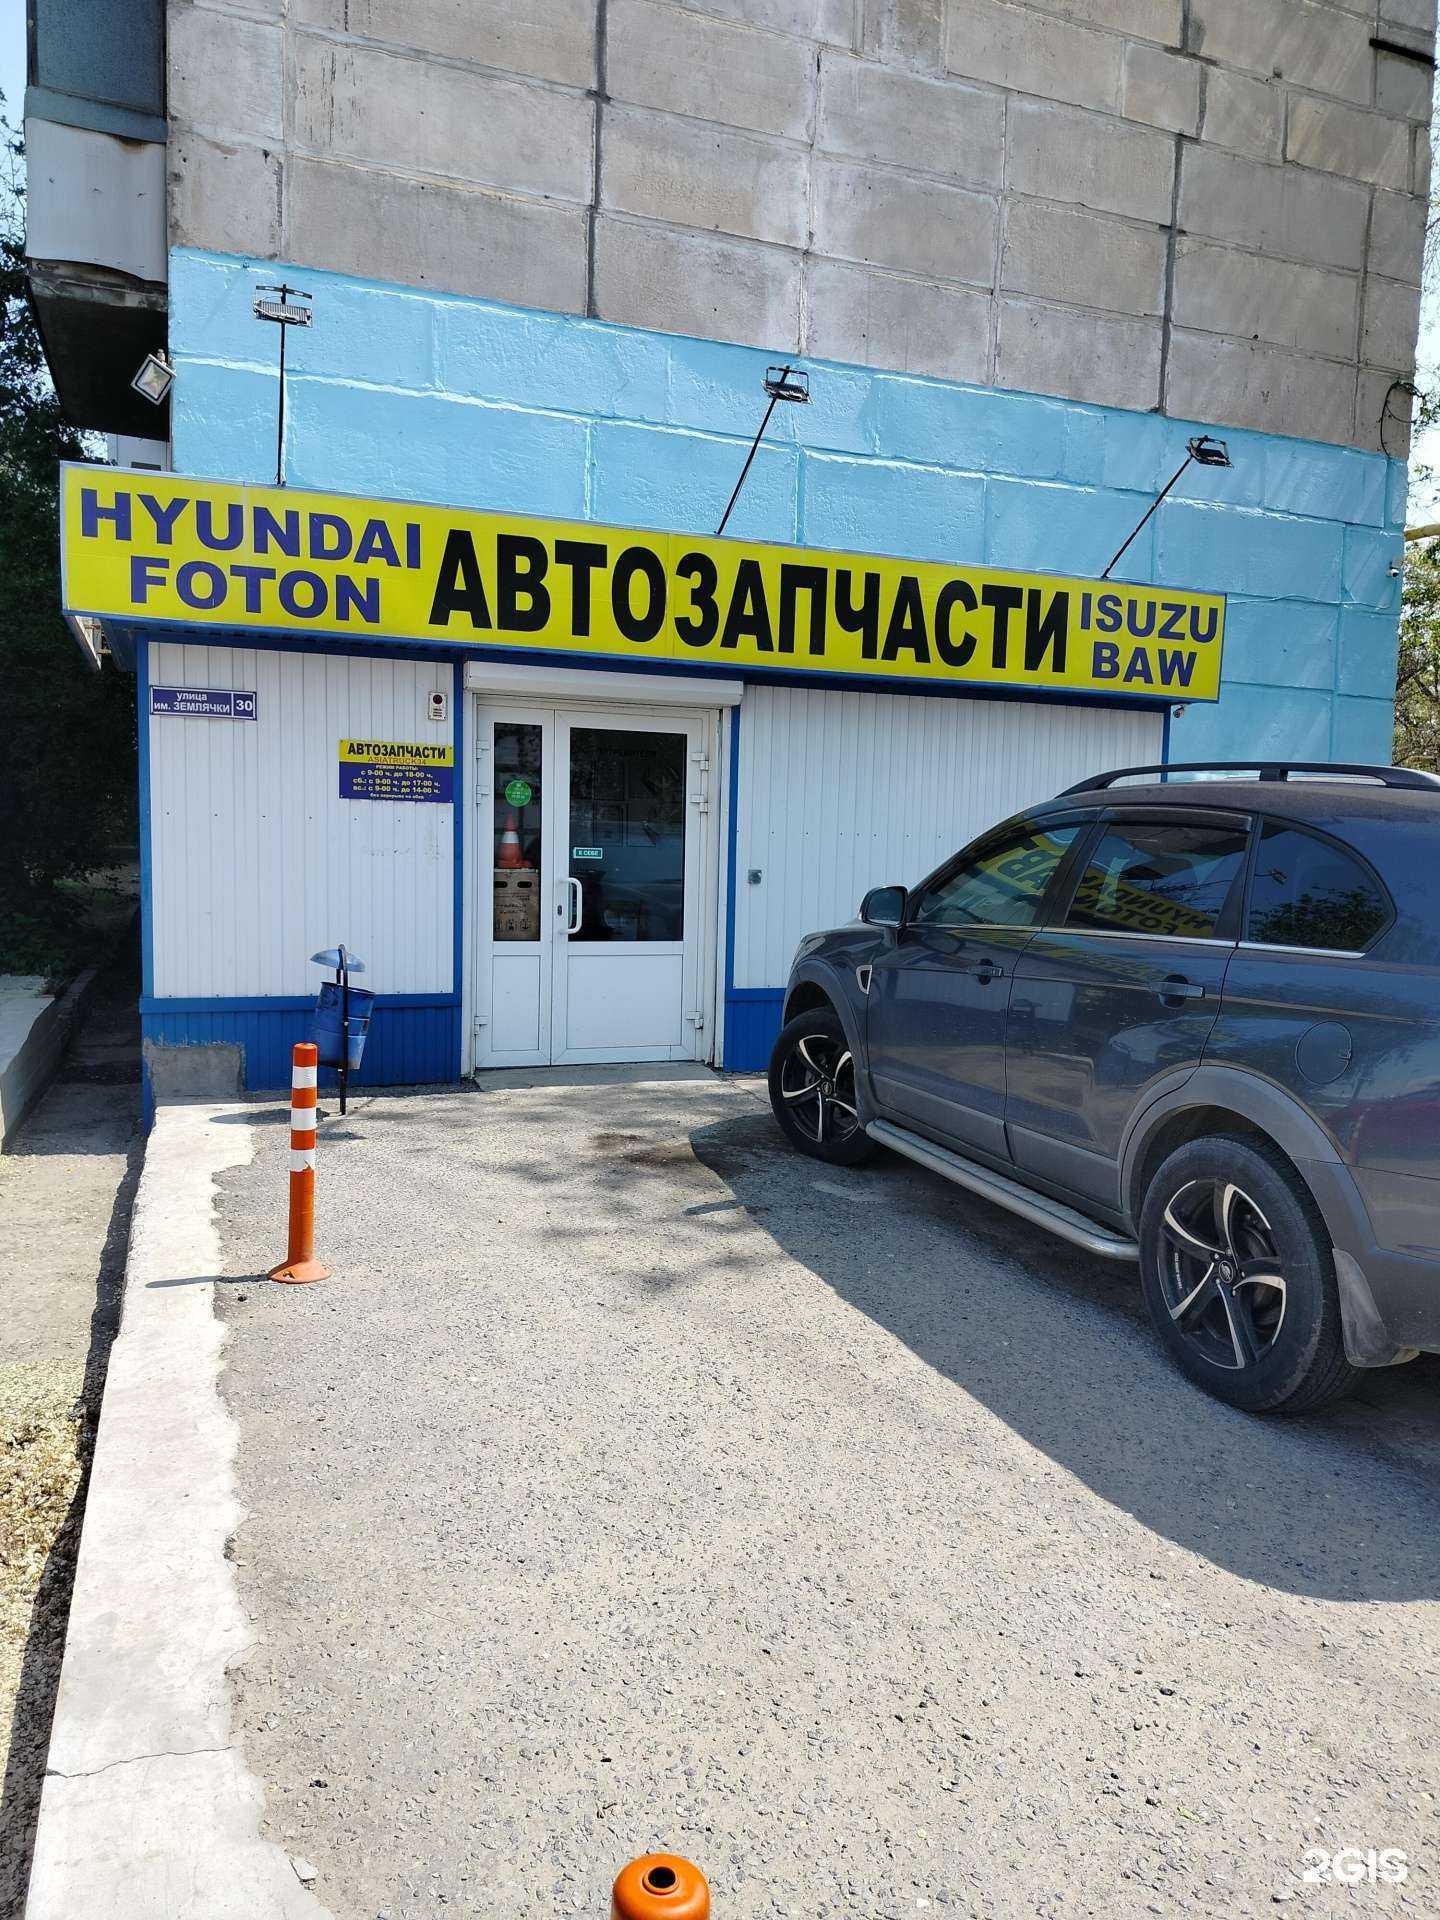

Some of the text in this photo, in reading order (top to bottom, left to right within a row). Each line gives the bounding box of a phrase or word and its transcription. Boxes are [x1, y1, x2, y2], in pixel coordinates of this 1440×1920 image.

[80, 488, 421, 569] HYUNDAI
[130, 556, 380, 623] FOTON
[428, 528, 1069, 673] АВТОЗАПЧАСТИ
[1080, 592, 1218, 643] ISUZU
[1092, 641, 1197, 688] BAW
[154, 701, 230, 713] им. ЗЕМЛЯЧКИ
[176, 692, 208, 701] улица
[236, 699, 253, 711] 30
[347, 742, 446, 759] АВТОЗАПЧАСТИ
